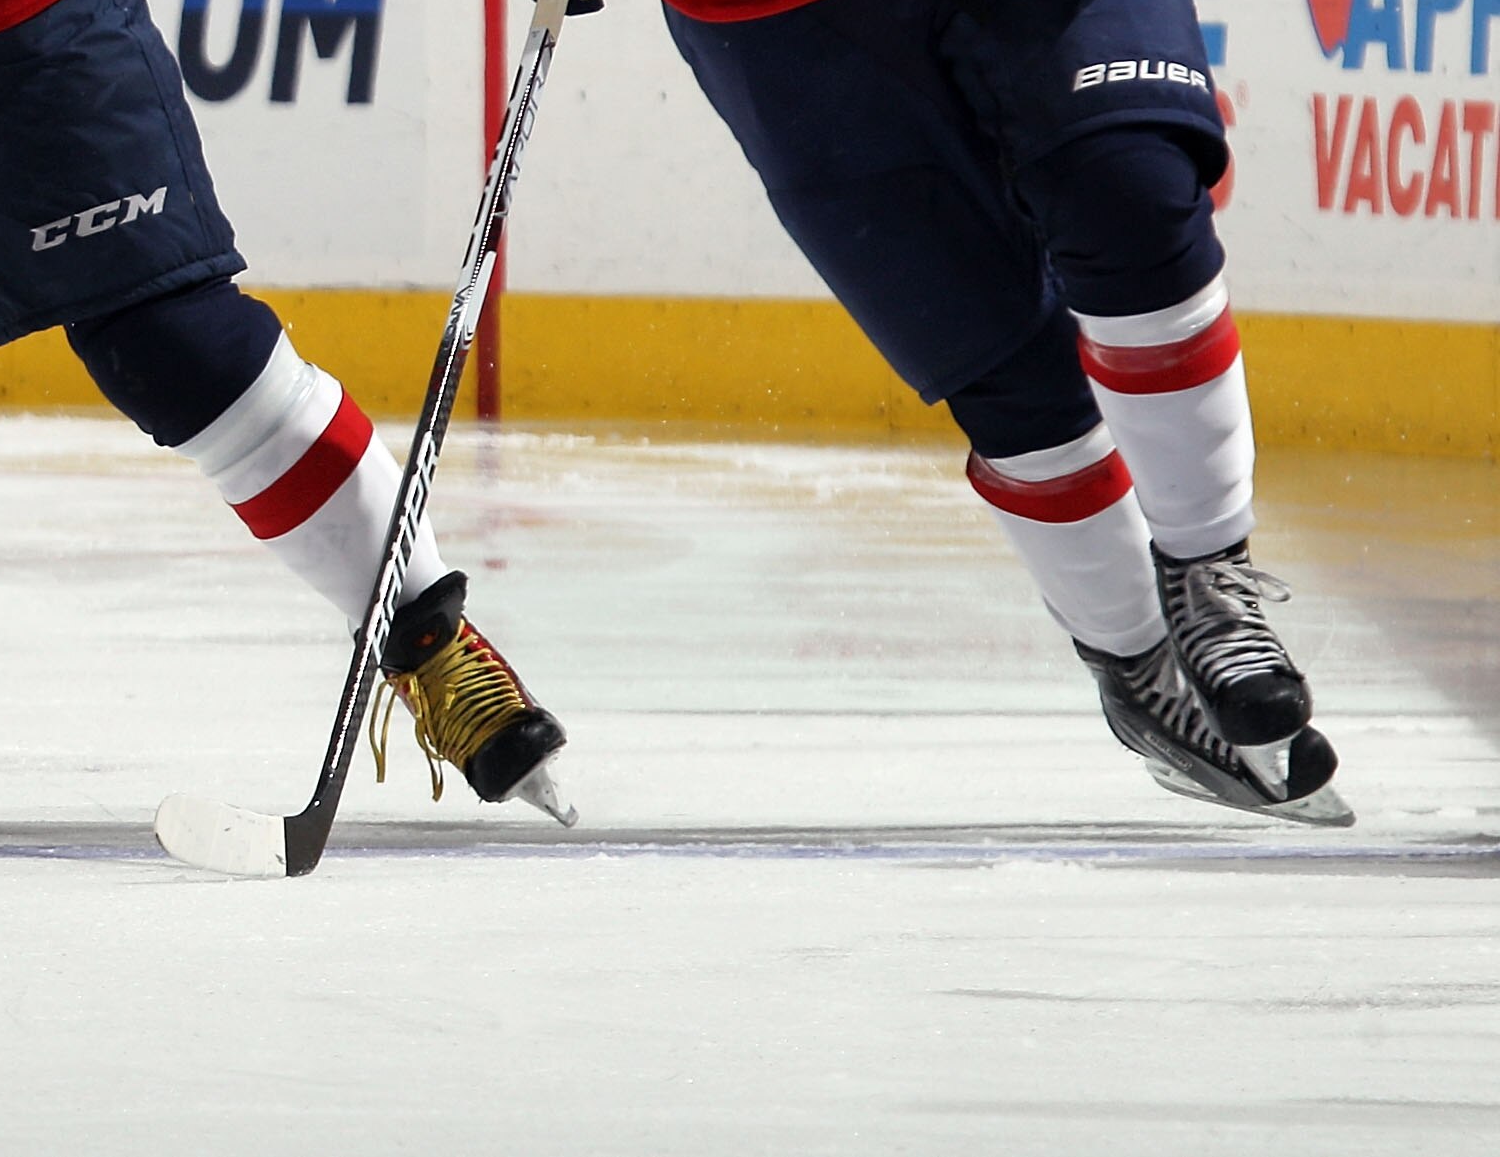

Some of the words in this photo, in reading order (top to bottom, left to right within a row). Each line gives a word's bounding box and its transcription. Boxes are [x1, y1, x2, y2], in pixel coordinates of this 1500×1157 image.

[1073, 59, 1211, 95] BAUER
[1312, 92, 1500, 221] VACAT
[29, 185, 168, 252] CCM
